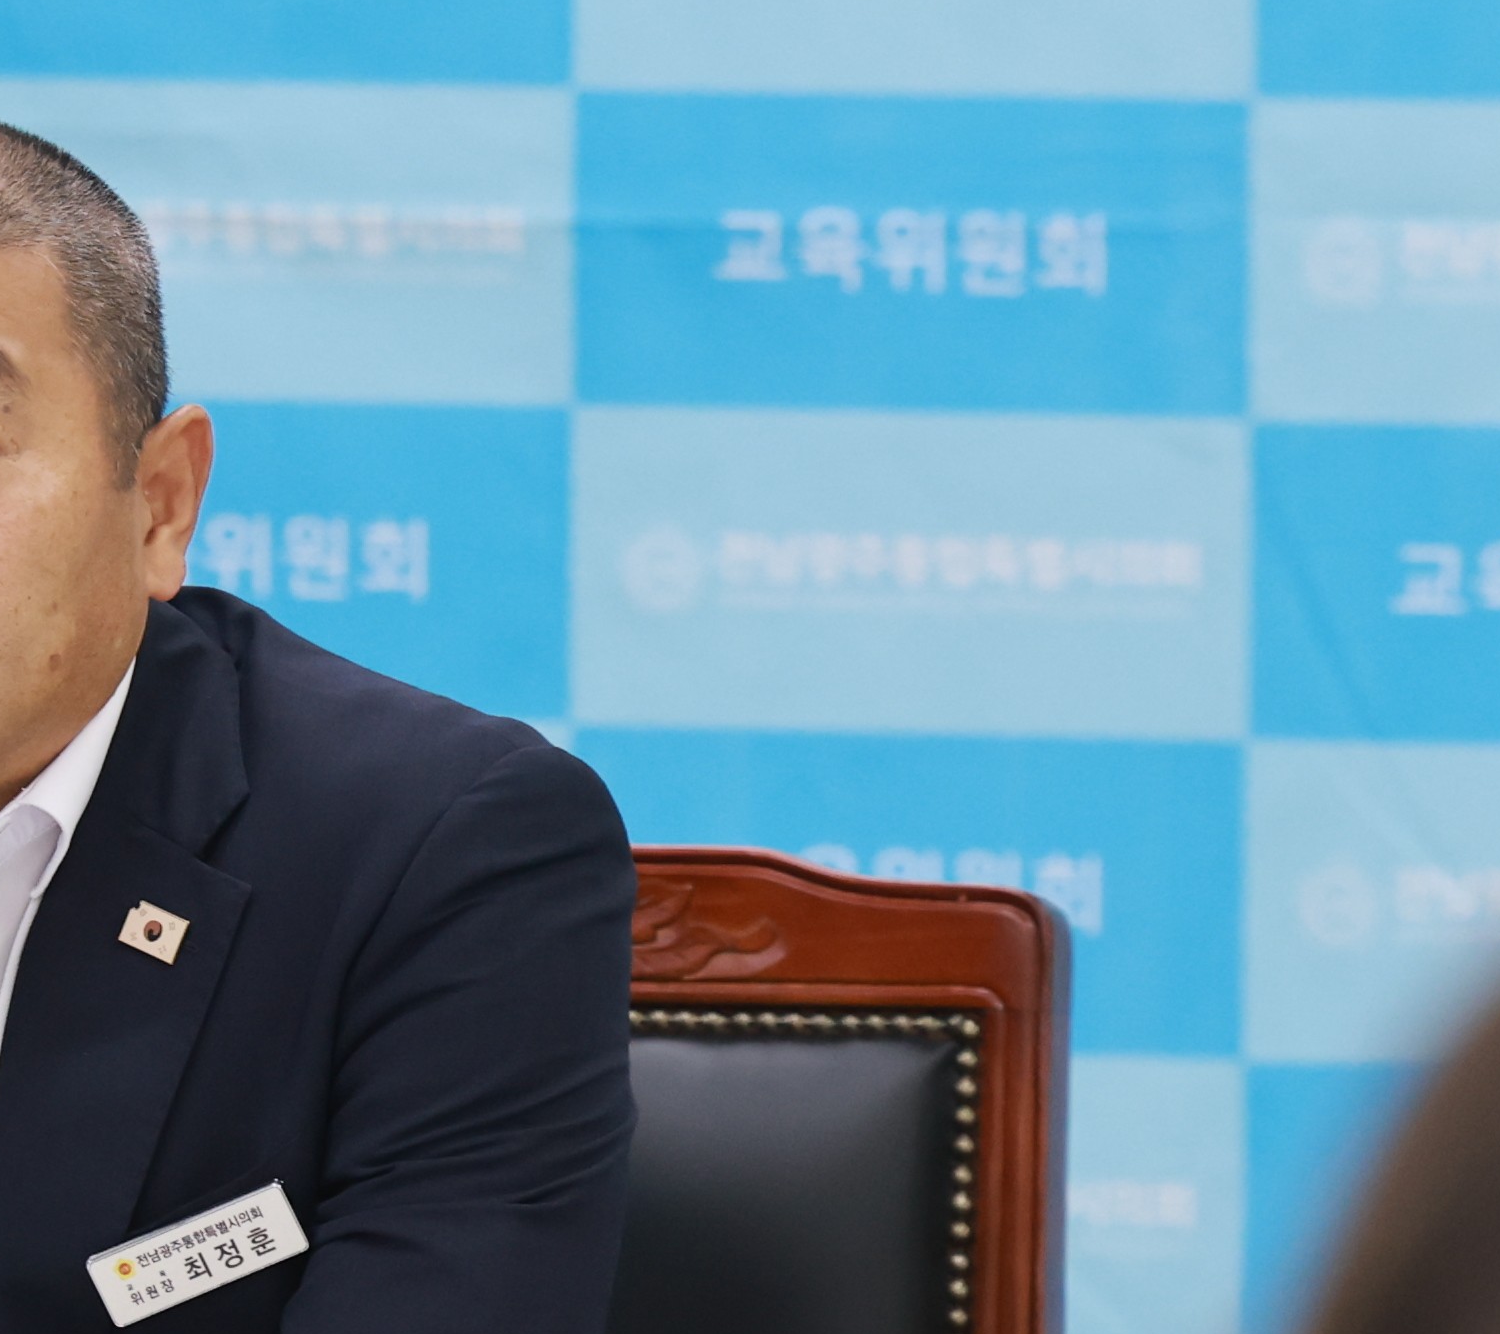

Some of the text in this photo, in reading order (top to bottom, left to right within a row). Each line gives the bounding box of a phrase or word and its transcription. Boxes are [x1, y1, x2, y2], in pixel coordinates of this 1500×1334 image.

[716, 201, 1110, 299] 교육위원회
[202, 510, 432, 604] 위원회
[183, 1225, 278, 1281] 최정훈
[129, 1278, 176, 1306] 위원장
